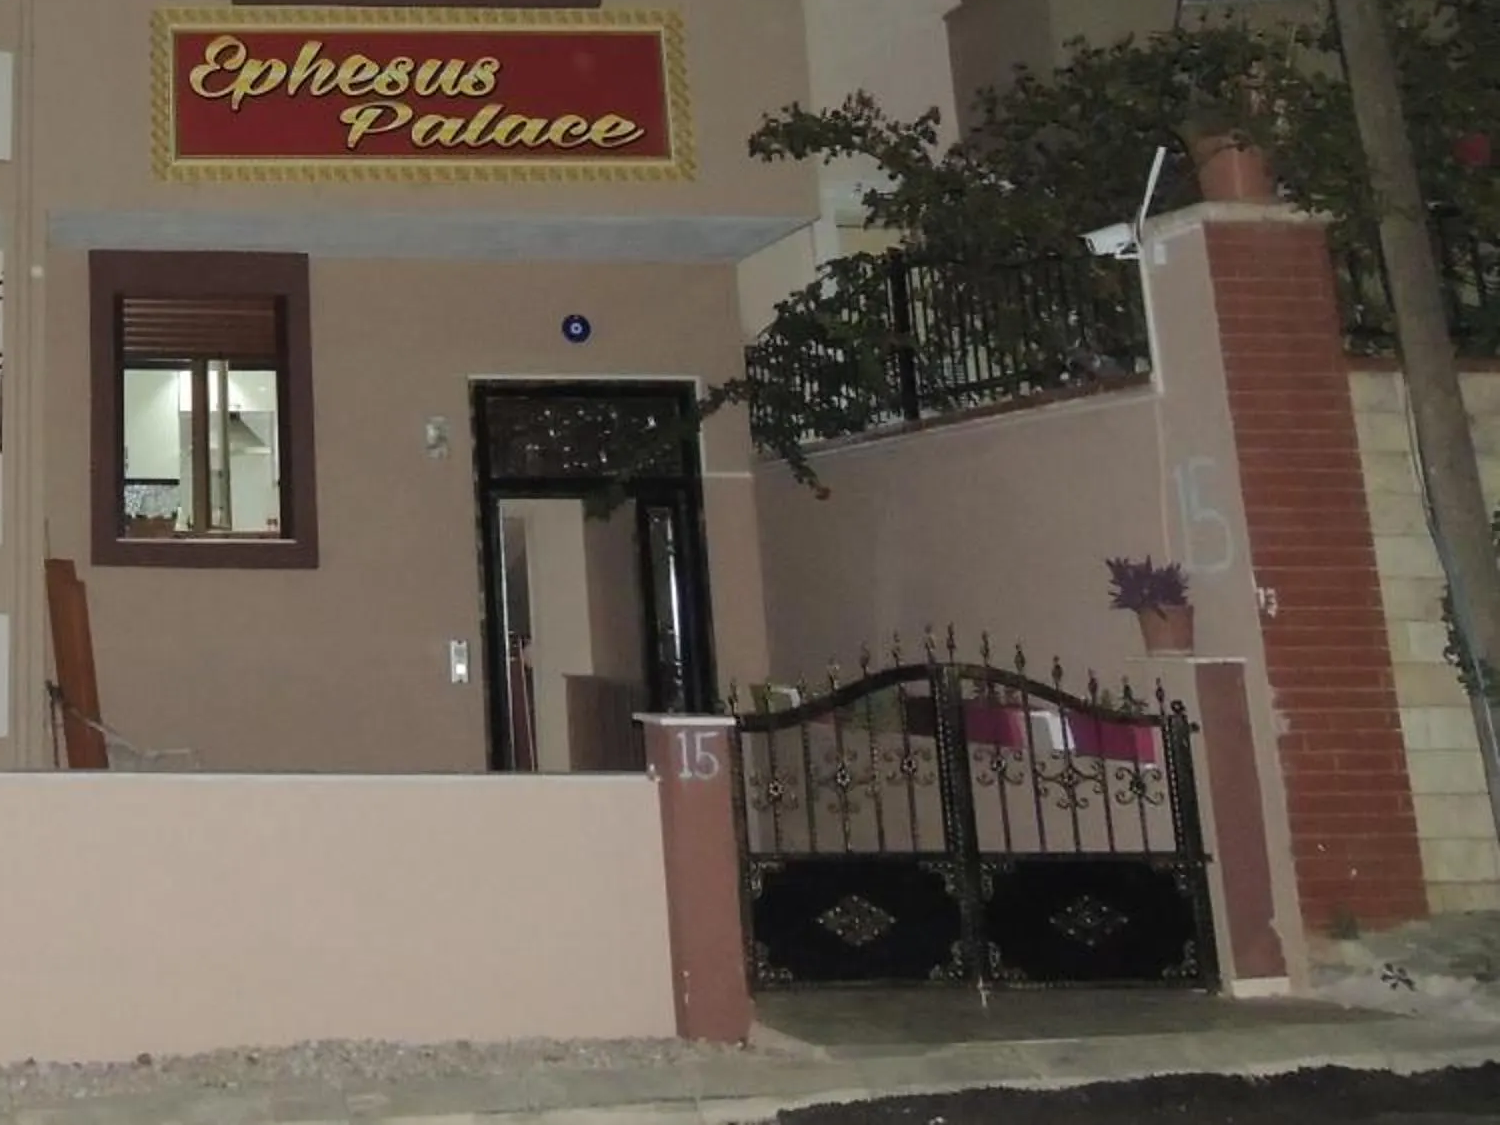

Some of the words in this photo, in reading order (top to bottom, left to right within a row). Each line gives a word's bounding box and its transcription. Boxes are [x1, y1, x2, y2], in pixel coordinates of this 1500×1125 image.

[189, 34, 502, 111] Ephesus
[339, 100, 645, 149] Palace
[676, 730, 721, 781] 15
